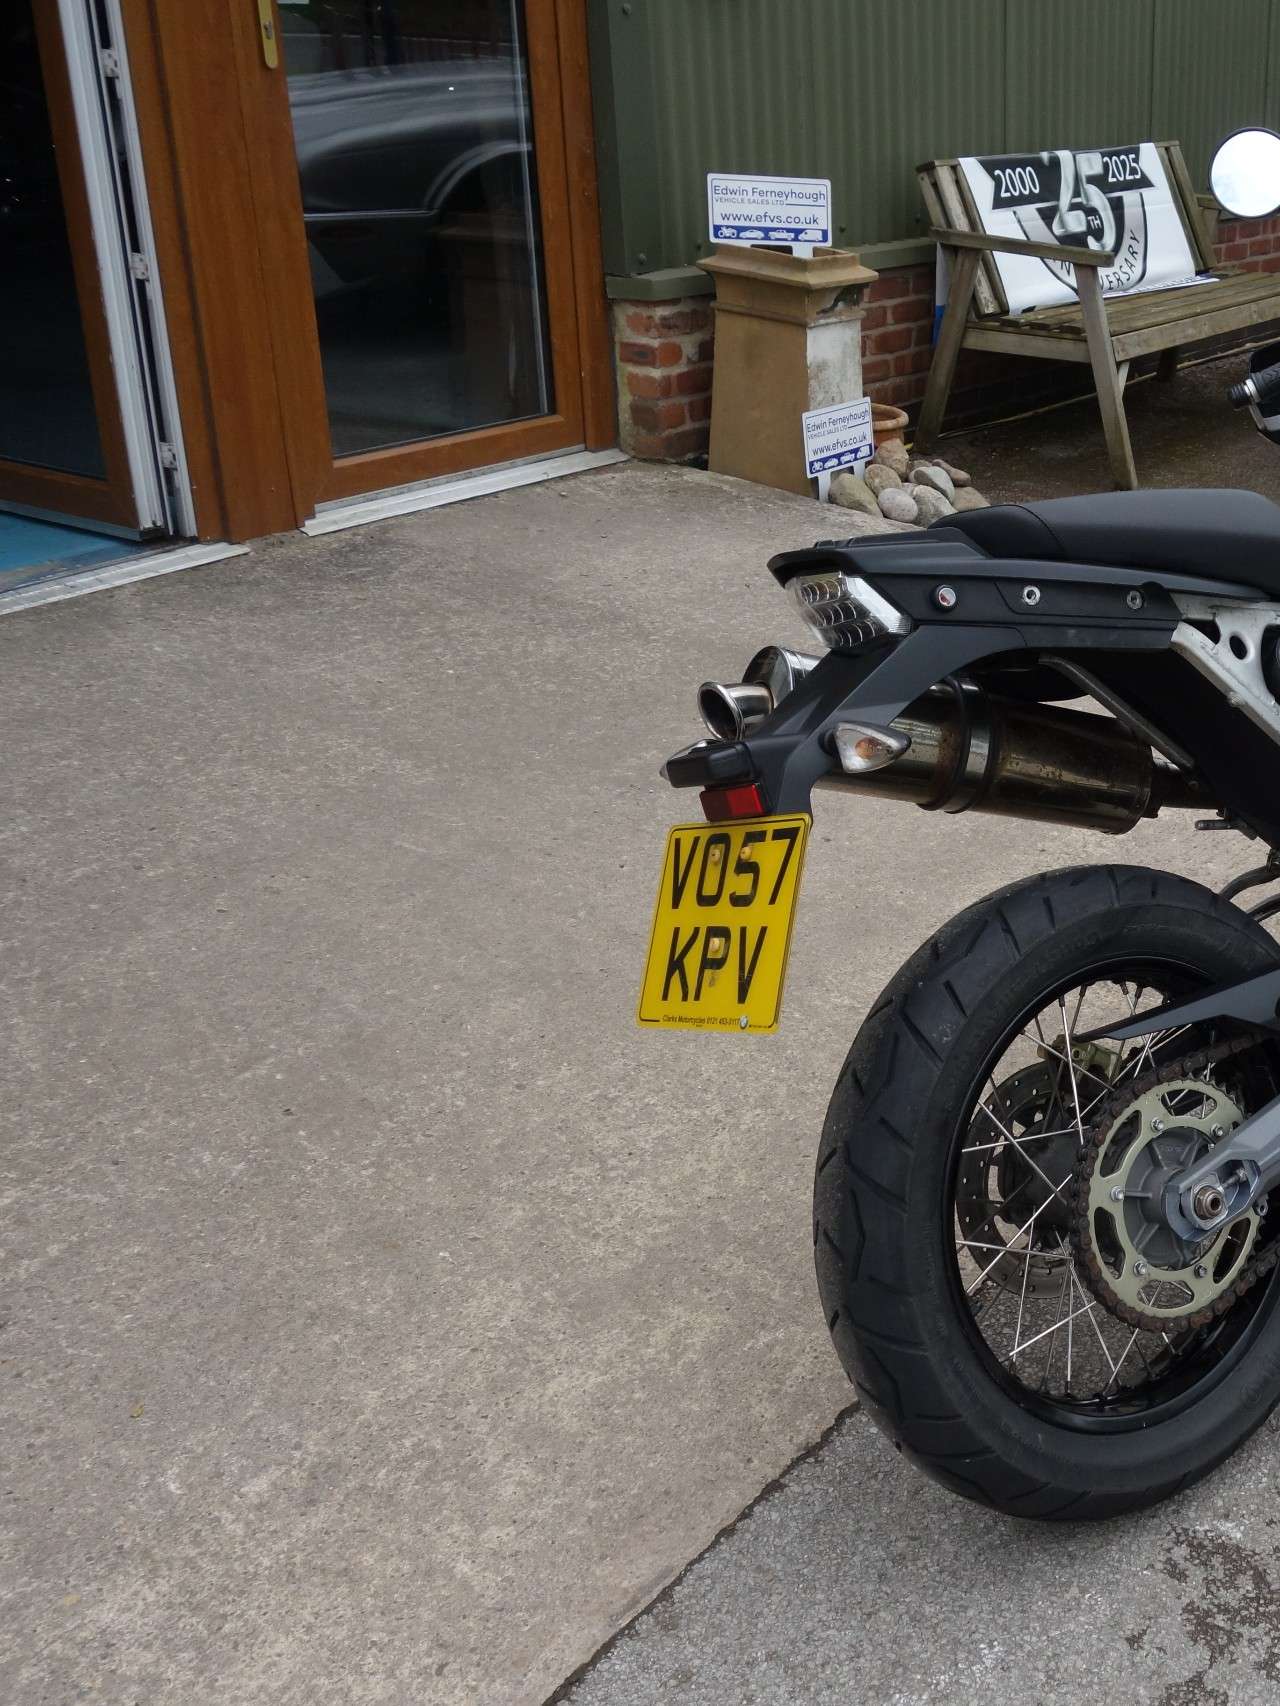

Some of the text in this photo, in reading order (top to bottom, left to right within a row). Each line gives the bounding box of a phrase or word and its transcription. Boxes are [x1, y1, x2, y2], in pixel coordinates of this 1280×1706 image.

[994, 166, 1040, 198] 2000
[1103, 153, 1142, 183] 2025
[713, 185, 826, 202] Edwin Ferneyhough
[1039, 150, 1116, 251] 25
[720, 211, 819, 225] www.efvs.co.uk
[1087, 214, 1102, 229] TH
[806, 407, 869, 433] Edwin Ferneyhough
[812, 431, 868, 457] www.efvs.co.uk
[671, 826, 801, 910] VO57
[661, 925, 769, 1005] KPV
